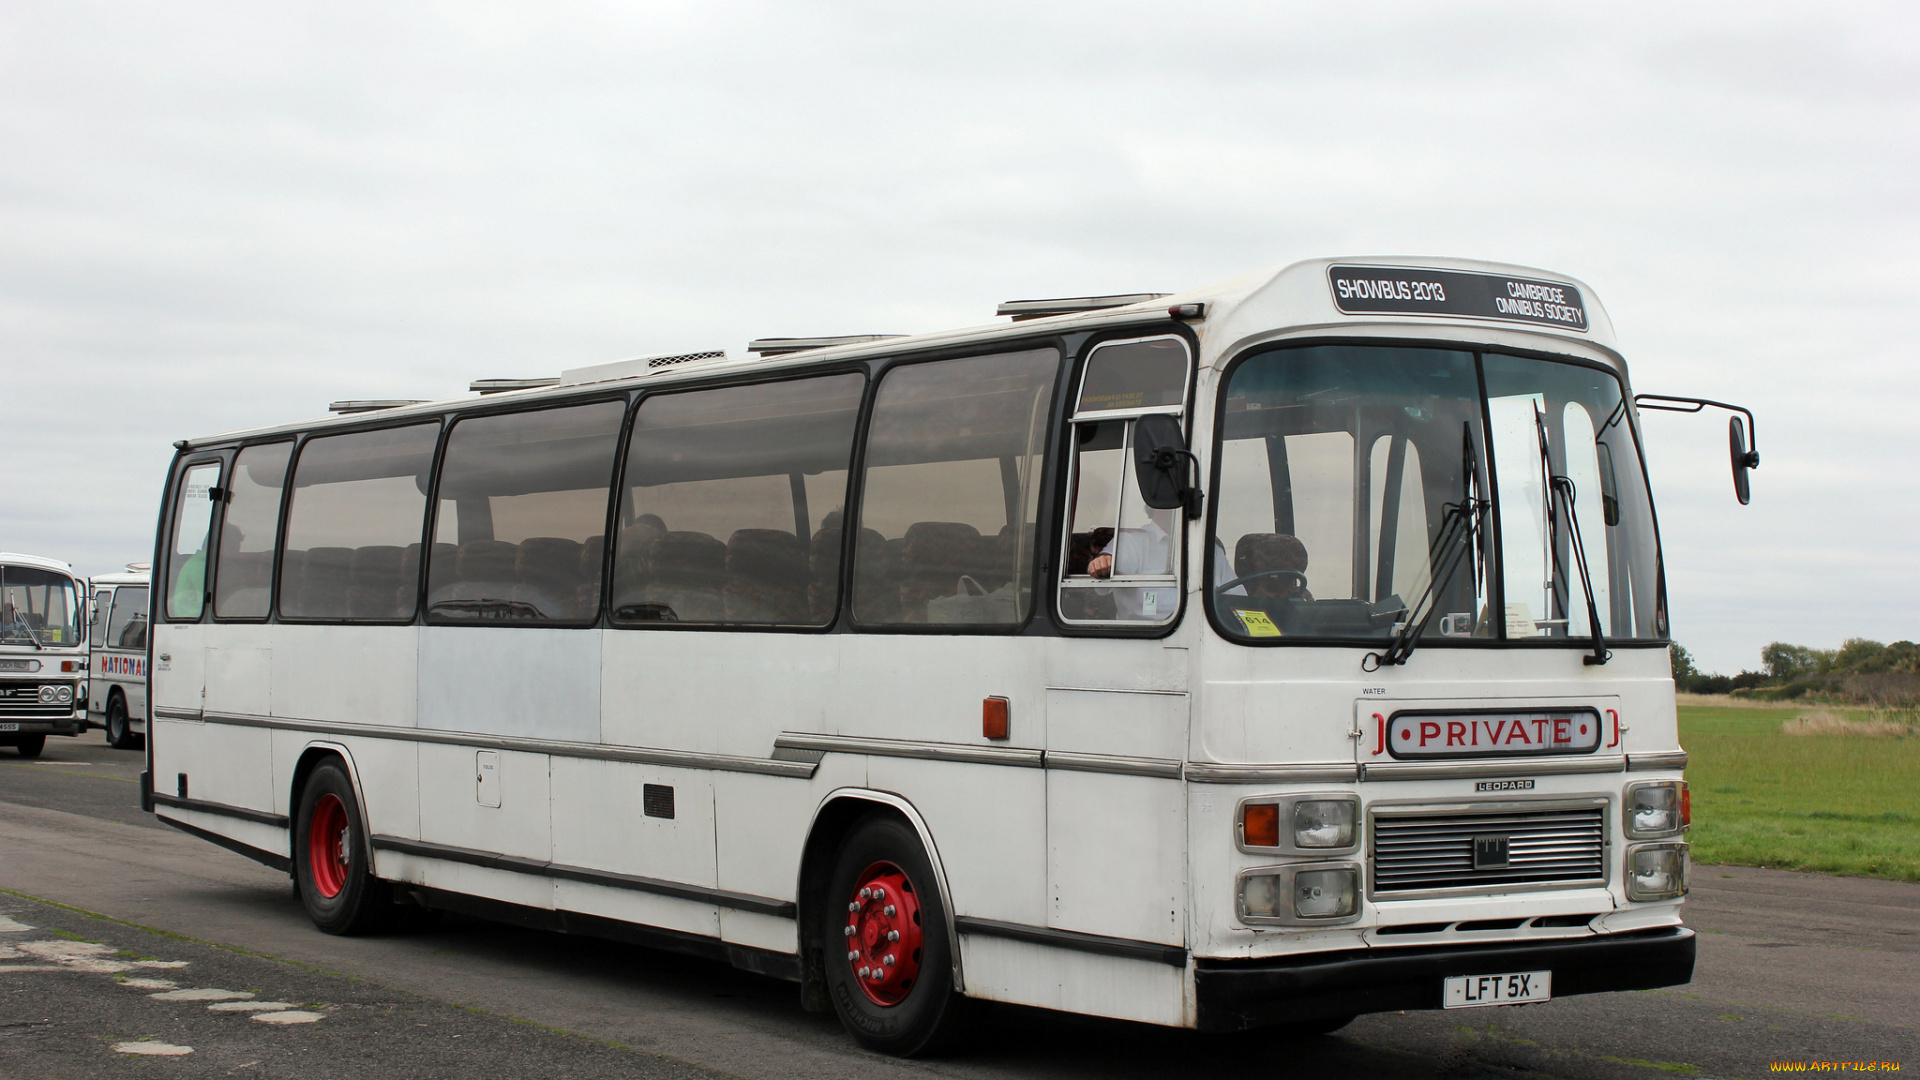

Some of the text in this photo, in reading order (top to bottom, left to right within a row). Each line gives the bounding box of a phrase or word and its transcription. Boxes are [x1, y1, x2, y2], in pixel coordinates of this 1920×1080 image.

[1337, 279, 1446, 302] SHOWBUS 2013
[1507, 281, 1566, 304] CAMBRIDGE
[1495, 297, 1583, 324] OMNIBUS SOCIETY
[1245, 616, 1271, 625] 614
[1362, 687, 1386, 695] WATER
[1418, 718, 1572, 747] PRIVATE
[1478, 780, 1532, 791] LEOPARD
[1465, 974, 1530, 1000] LFT 5X
[838, 985, 882, 1032] MICHELIN
